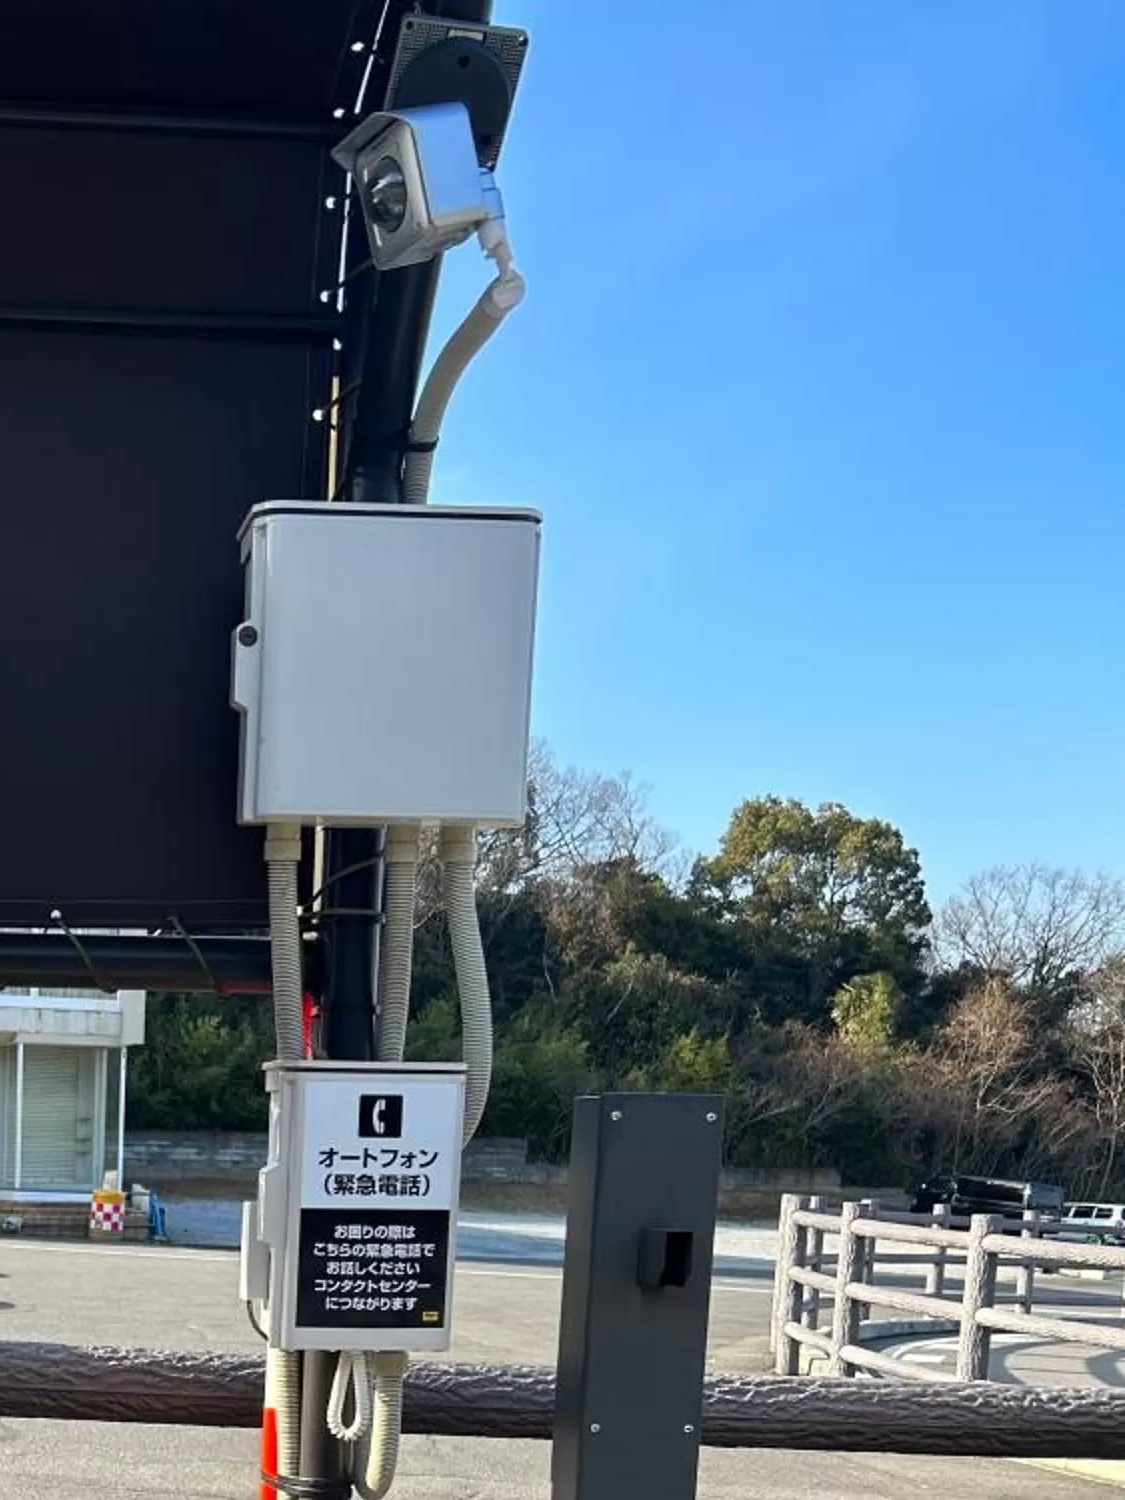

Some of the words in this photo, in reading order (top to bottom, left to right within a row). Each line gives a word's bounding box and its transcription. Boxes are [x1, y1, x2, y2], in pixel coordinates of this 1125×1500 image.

[318, 1147, 438, 1170] オートフォン
[334, 1225, 416, 1240] お困りの際は
[313, 1242, 436, 1259] こちらの緊急電話で
[326, 1261, 421, 1276] お話しください
[314, 1279, 432, 1294] コンタクトセンター
[325, 1296, 418, 1312] につながります
